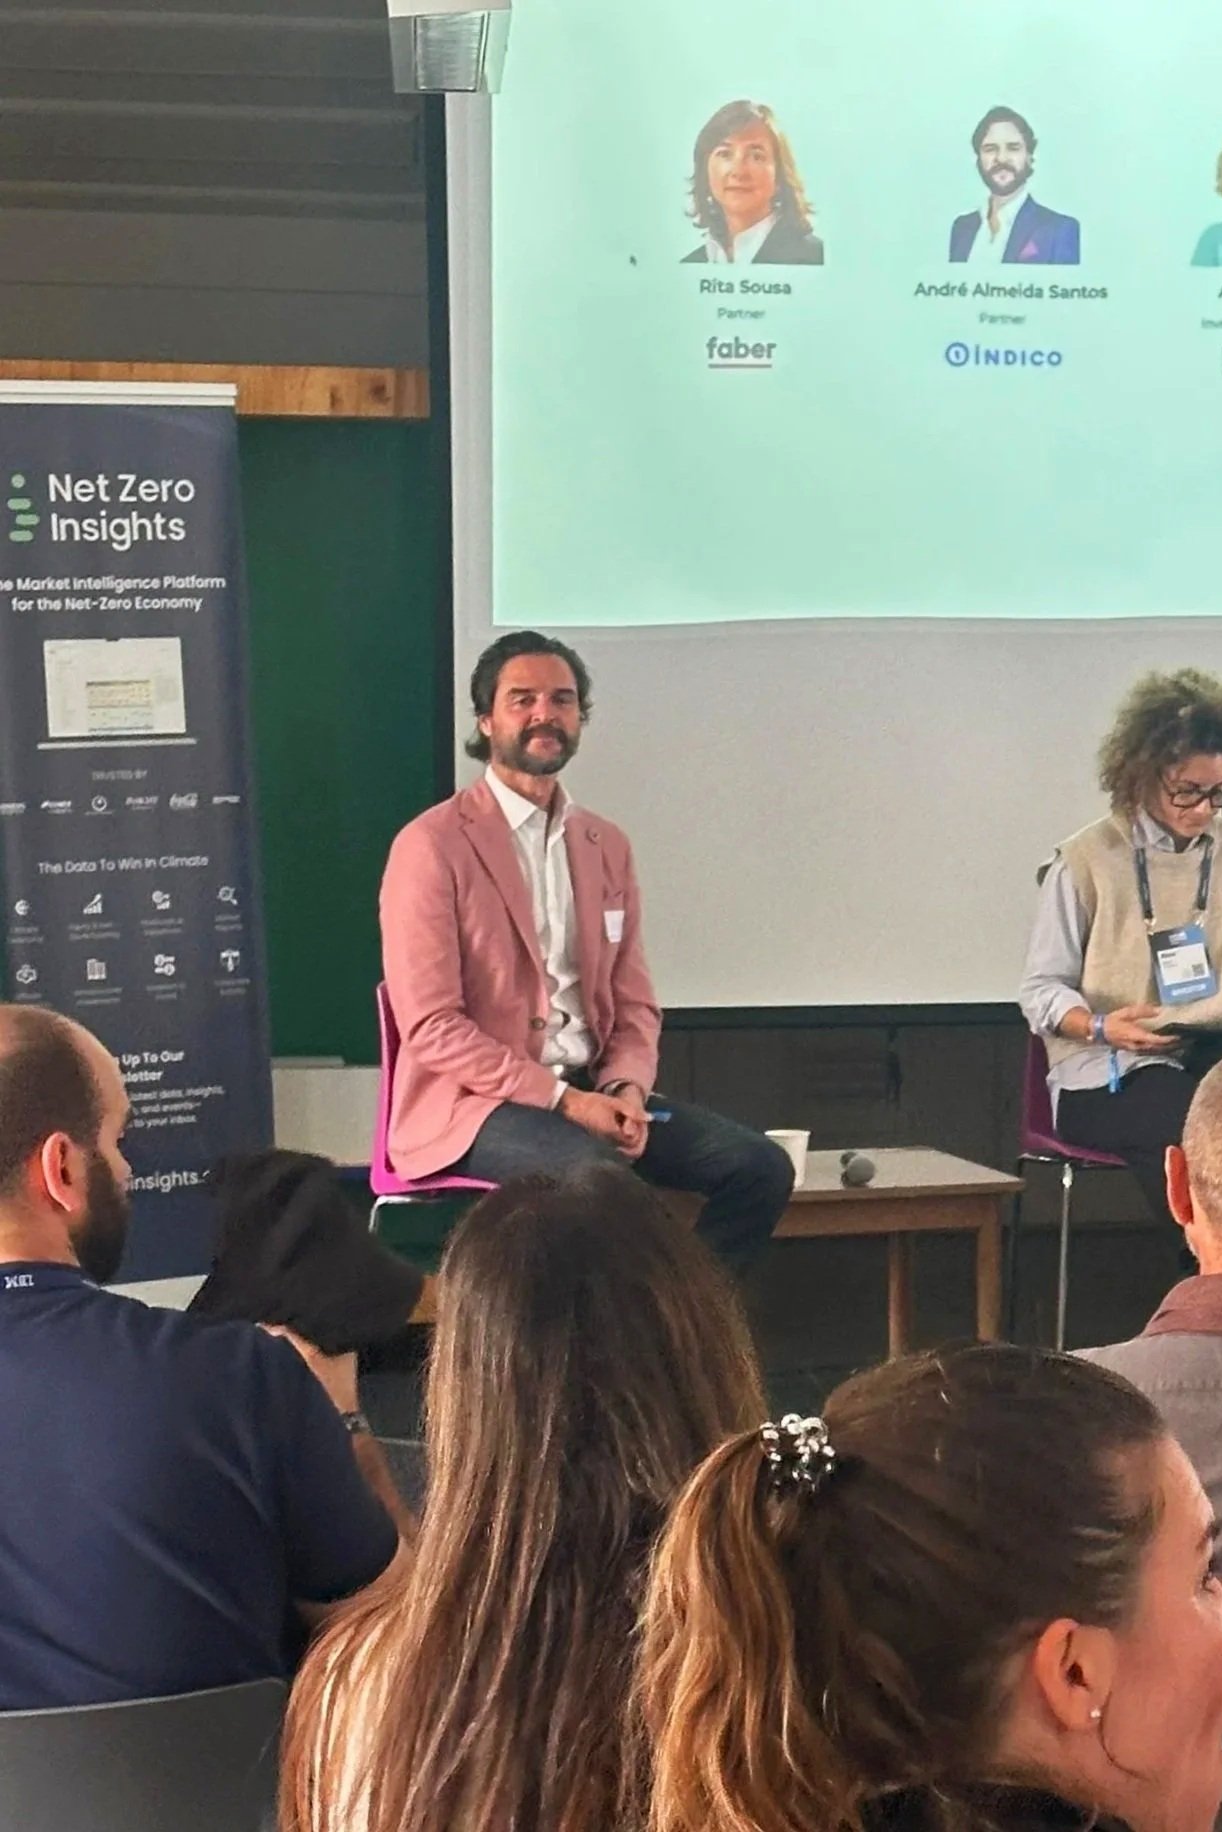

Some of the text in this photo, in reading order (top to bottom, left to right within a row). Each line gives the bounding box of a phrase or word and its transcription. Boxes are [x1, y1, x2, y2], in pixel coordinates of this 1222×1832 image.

[699, 278, 792, 295] Rita Sousa
[914, 281, 1109, 299] André Almeida Santos
[717, 307, 766, 319] Partner
[706, 336, 777, 359] faber
[48, 473, 196, 503] Net Zero
[50, 510, 187, 552] Insights
[16, 577, 71, 591] Market
[73, 575, 160, 594] Intelligence
[163, 574, 226, 589] Platform
[11, 595, 204, 613] for the Net-Zero Economy
[39, 861, 63, 875] The
[64, 859, 98, 874] Data
[100, 858, 116, 871] To
[117, 856, 143, 871] Win
[159, 855, 209, 869] Climate
[122, 1054, 141, 1068] Up
[143, 1052, 158, 1063] To
[160, 1050, 185, 1062] Our
